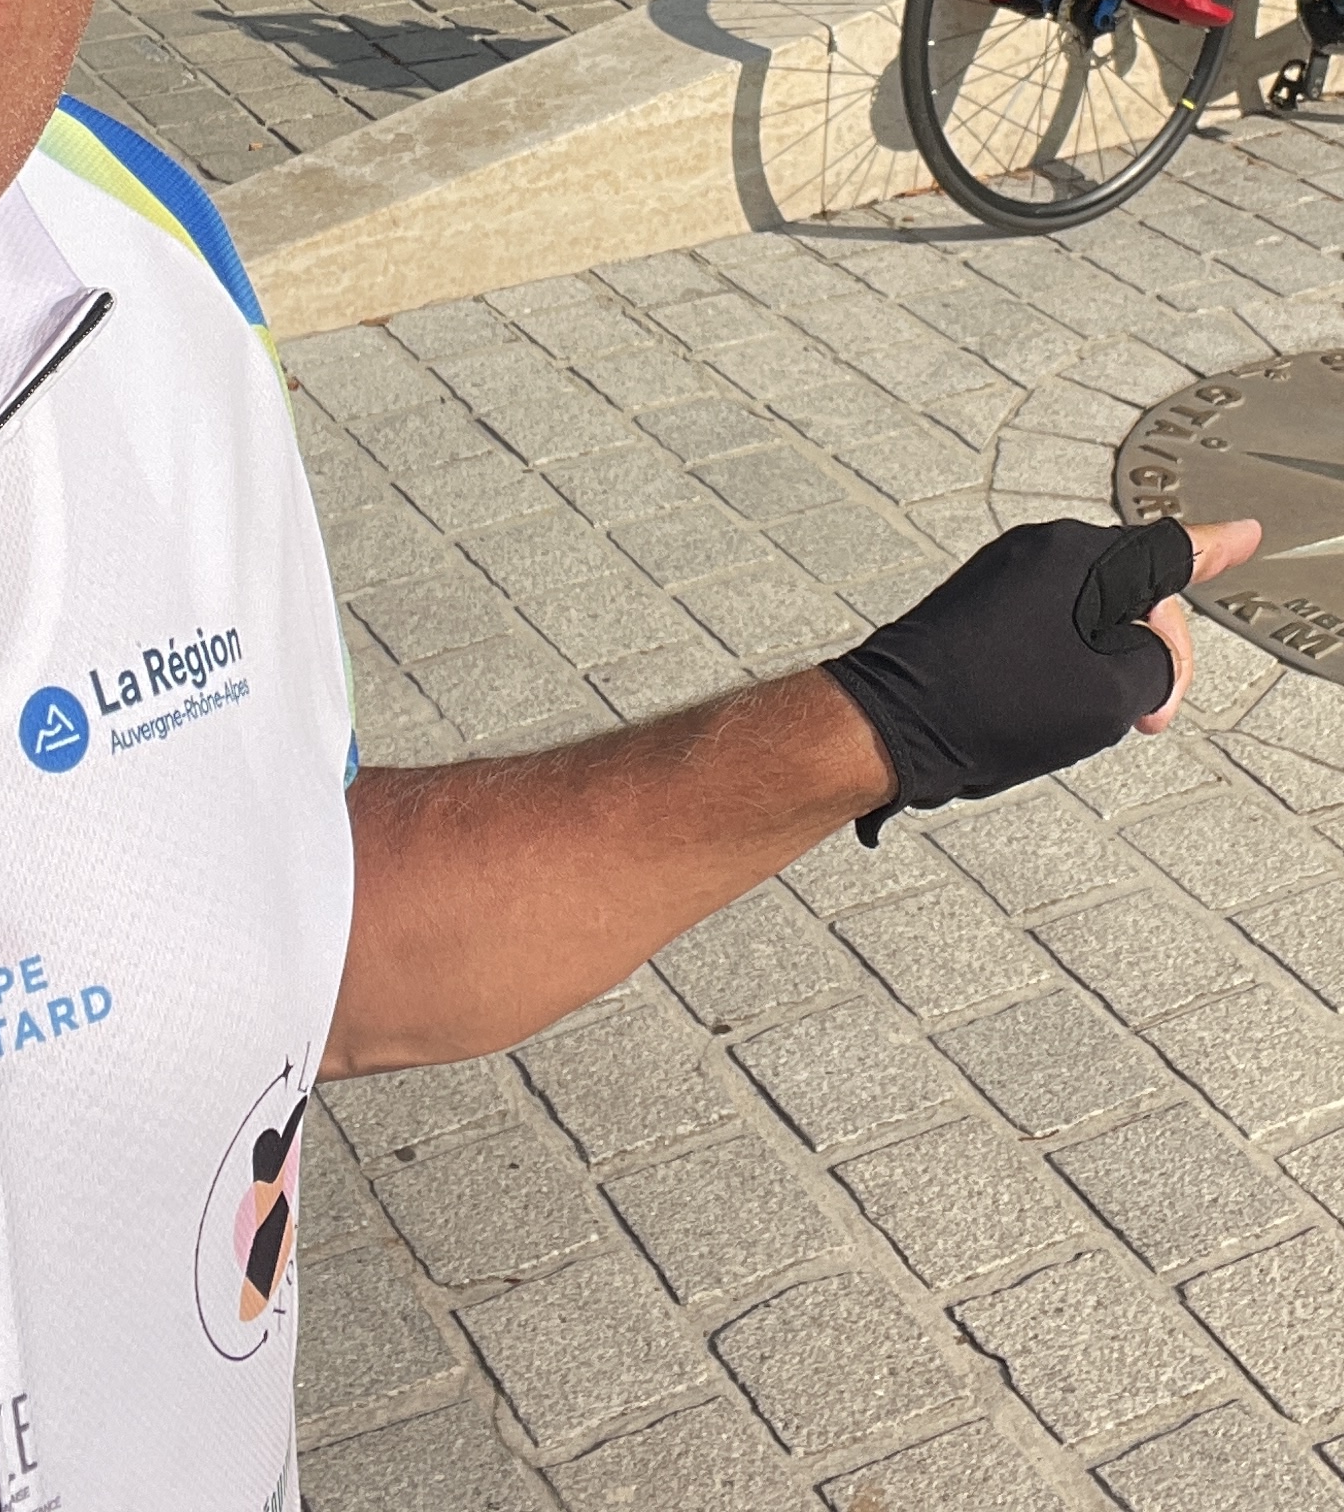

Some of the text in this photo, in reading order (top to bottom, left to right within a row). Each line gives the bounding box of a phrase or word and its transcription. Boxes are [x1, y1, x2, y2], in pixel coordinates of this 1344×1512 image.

[1214, 590, 1343, 661] KM
[89, 627, 243, 716] La Région
[110, 678, 251, 756] Auvergne-Rhône-Alpes
